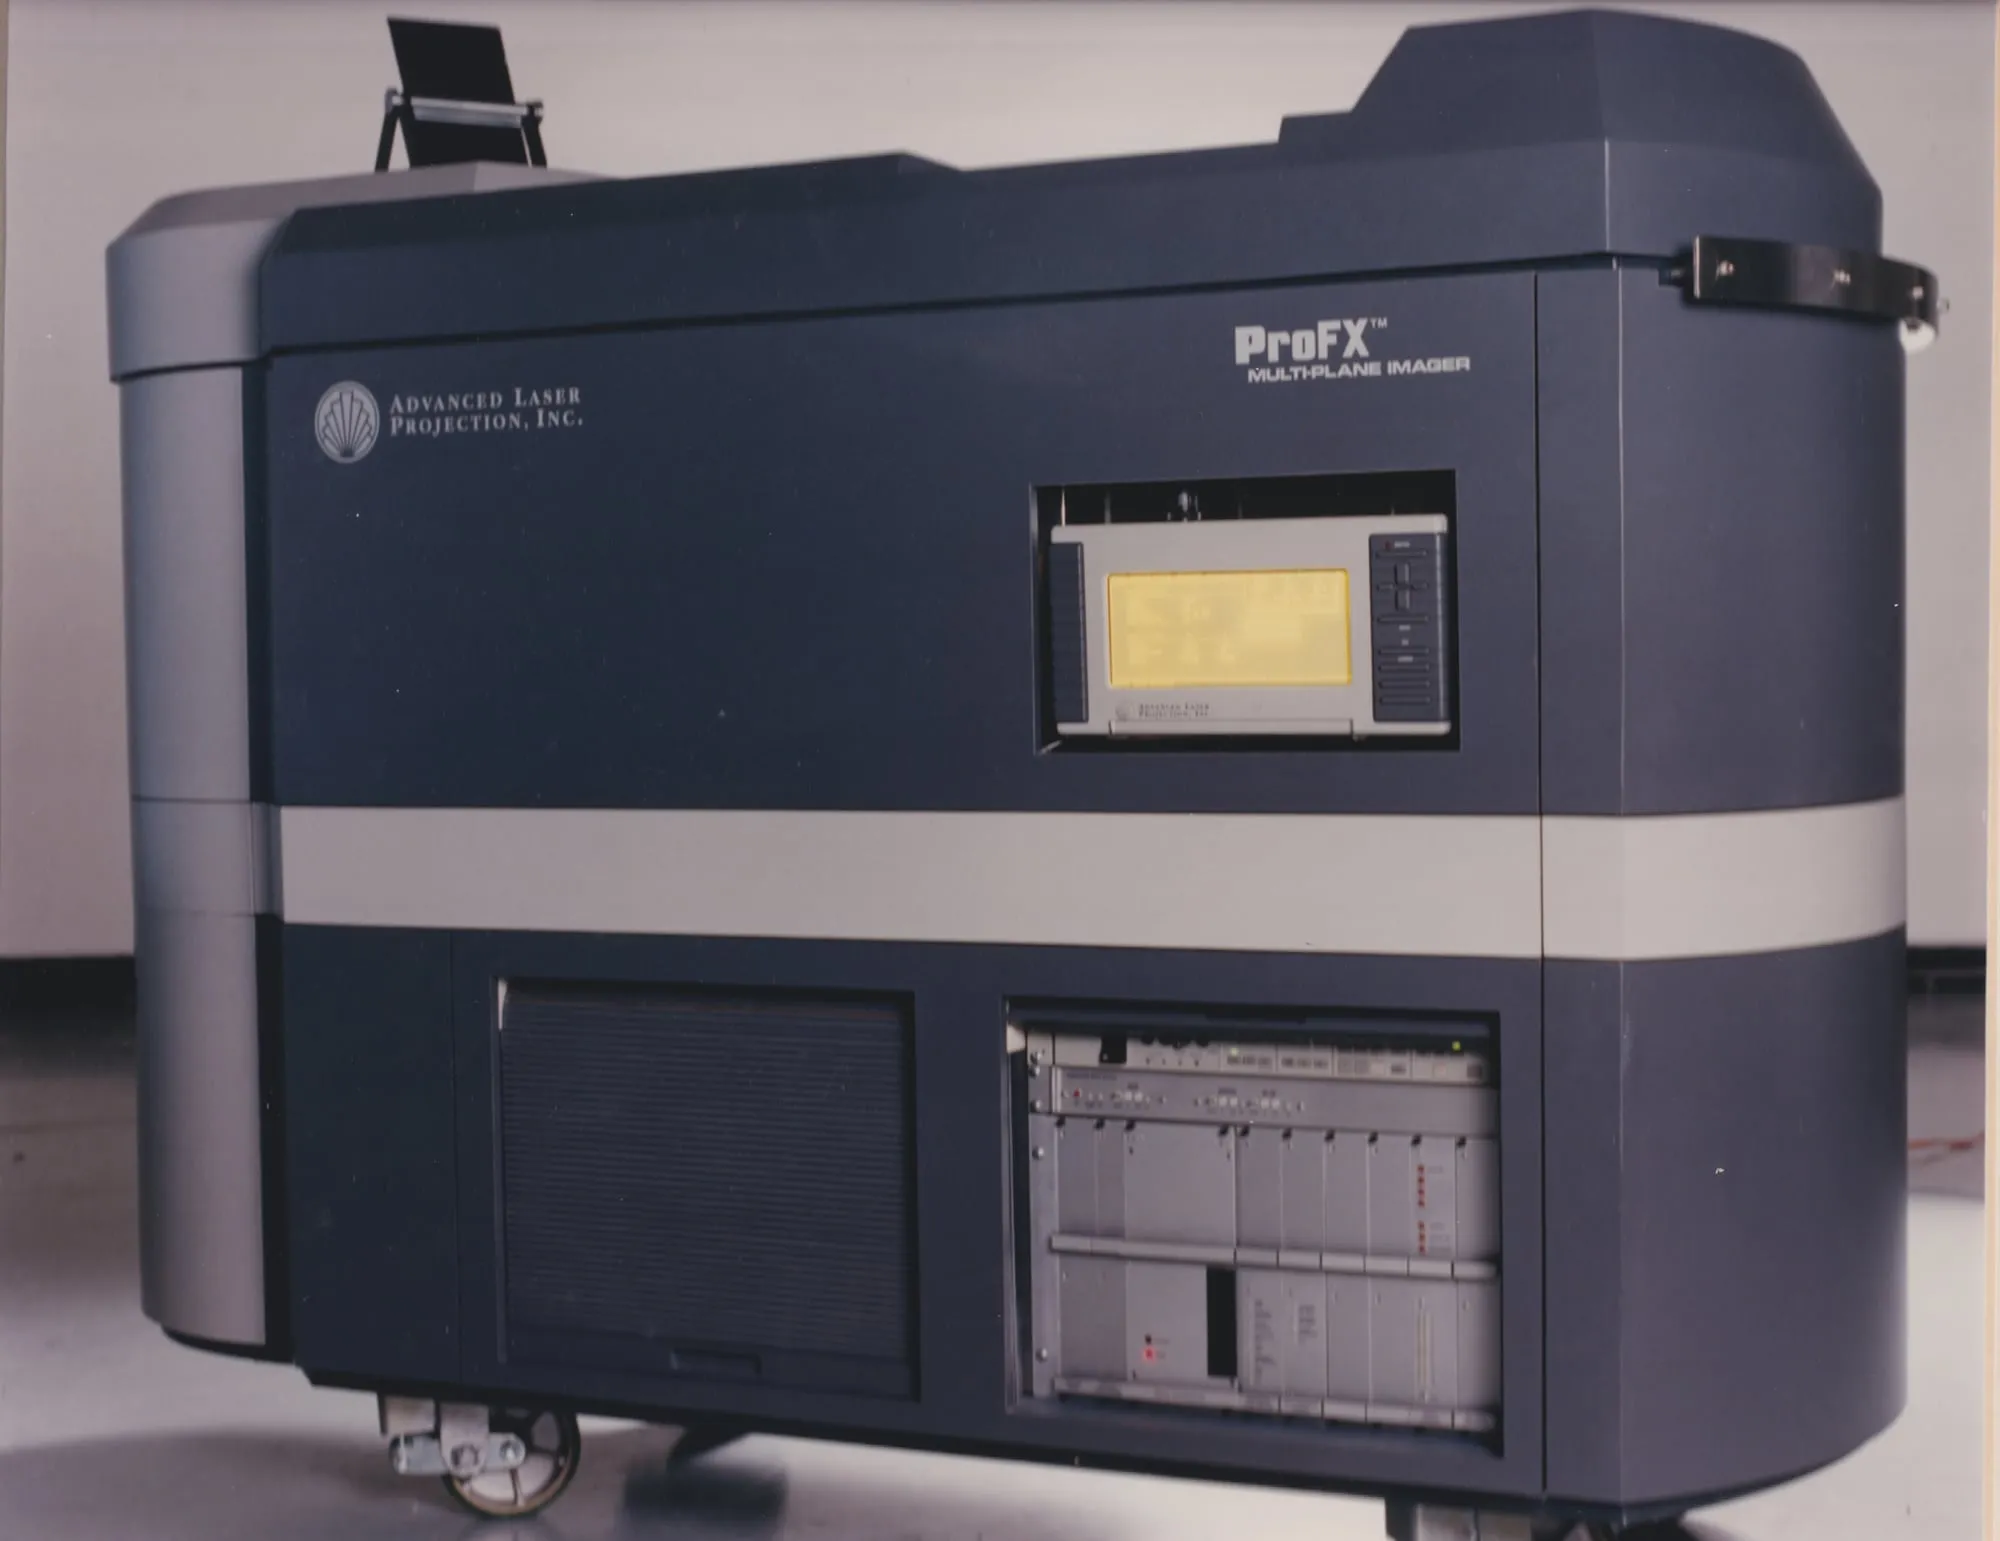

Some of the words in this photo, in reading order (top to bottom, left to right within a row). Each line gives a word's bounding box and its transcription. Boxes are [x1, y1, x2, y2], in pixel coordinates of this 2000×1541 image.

[1247, 361, 1381, 384] MULTI-PLANE
[1387, 356, 1471, 376] IMAGER
[389, 391, 503, 415] ADVANCED
[514, 386, 582, 408] LASER
[389, 411, 529, 438] PROJECTION,
[536, 407, 584, 429] INC.
